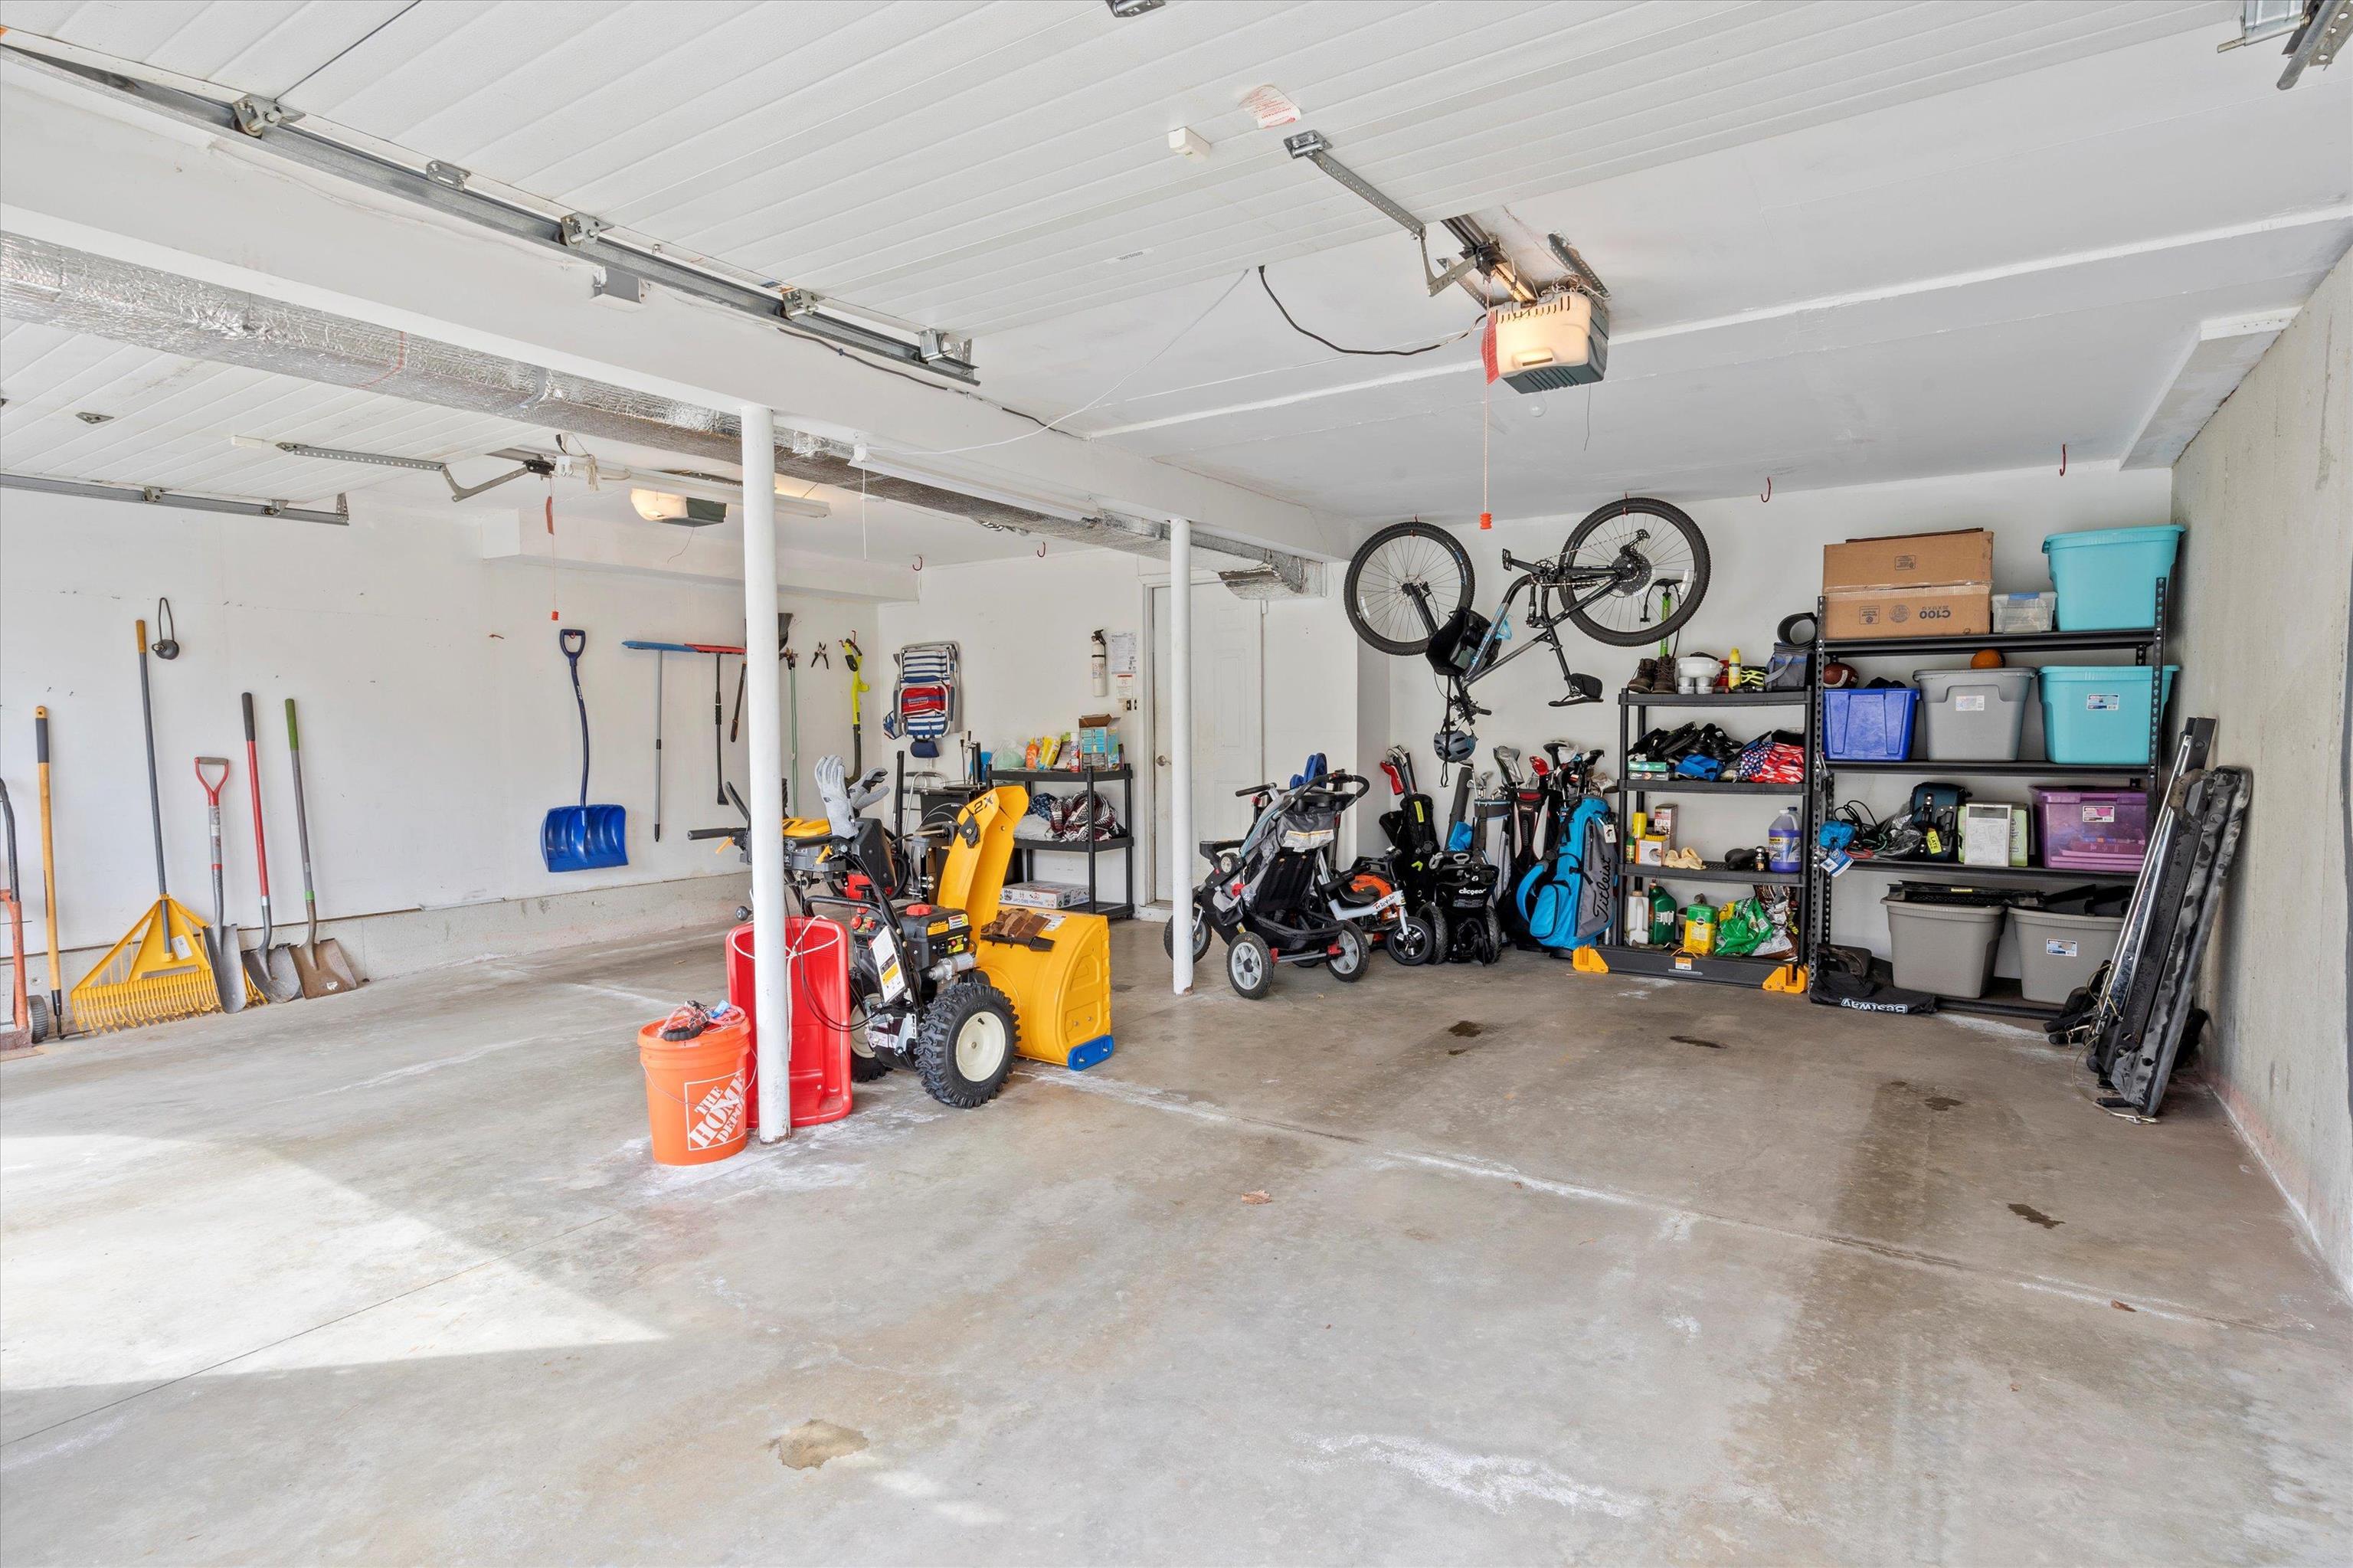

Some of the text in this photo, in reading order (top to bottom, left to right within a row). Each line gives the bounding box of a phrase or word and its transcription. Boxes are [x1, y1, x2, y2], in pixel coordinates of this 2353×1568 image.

[1919, 610, 1951, 619] C100
[974, 796, 993, 814] 2X
[1458, 887, 1487, 895] clicgear
[1593, 855, 1612, 923] Titleist
[1841, 997, 1908, 1014] Bestway
[694, 1085, 724, 1115] THE
[689, 1072, 745, 1147] HOME
